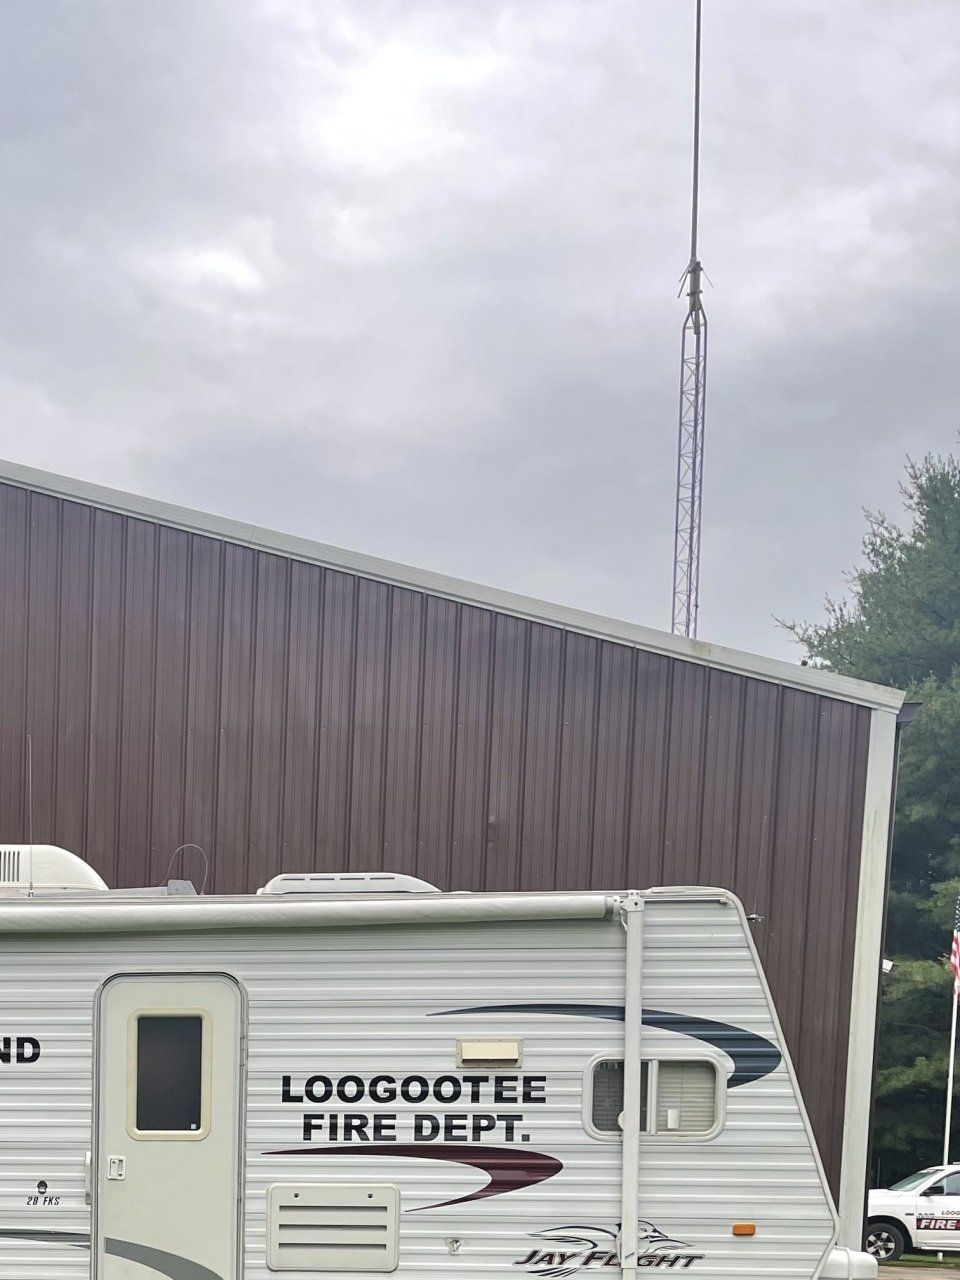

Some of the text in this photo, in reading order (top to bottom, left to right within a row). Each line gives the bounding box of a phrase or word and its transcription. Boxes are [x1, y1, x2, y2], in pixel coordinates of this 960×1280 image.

[282, 1075, 547, 1103] LOOGOOTEE
[303, 1113, 530, 1142] FIRE DEPT.
[920, 1219, 957, 1229] FIRE
[581, 1251, 706, 1269] FLGHT
